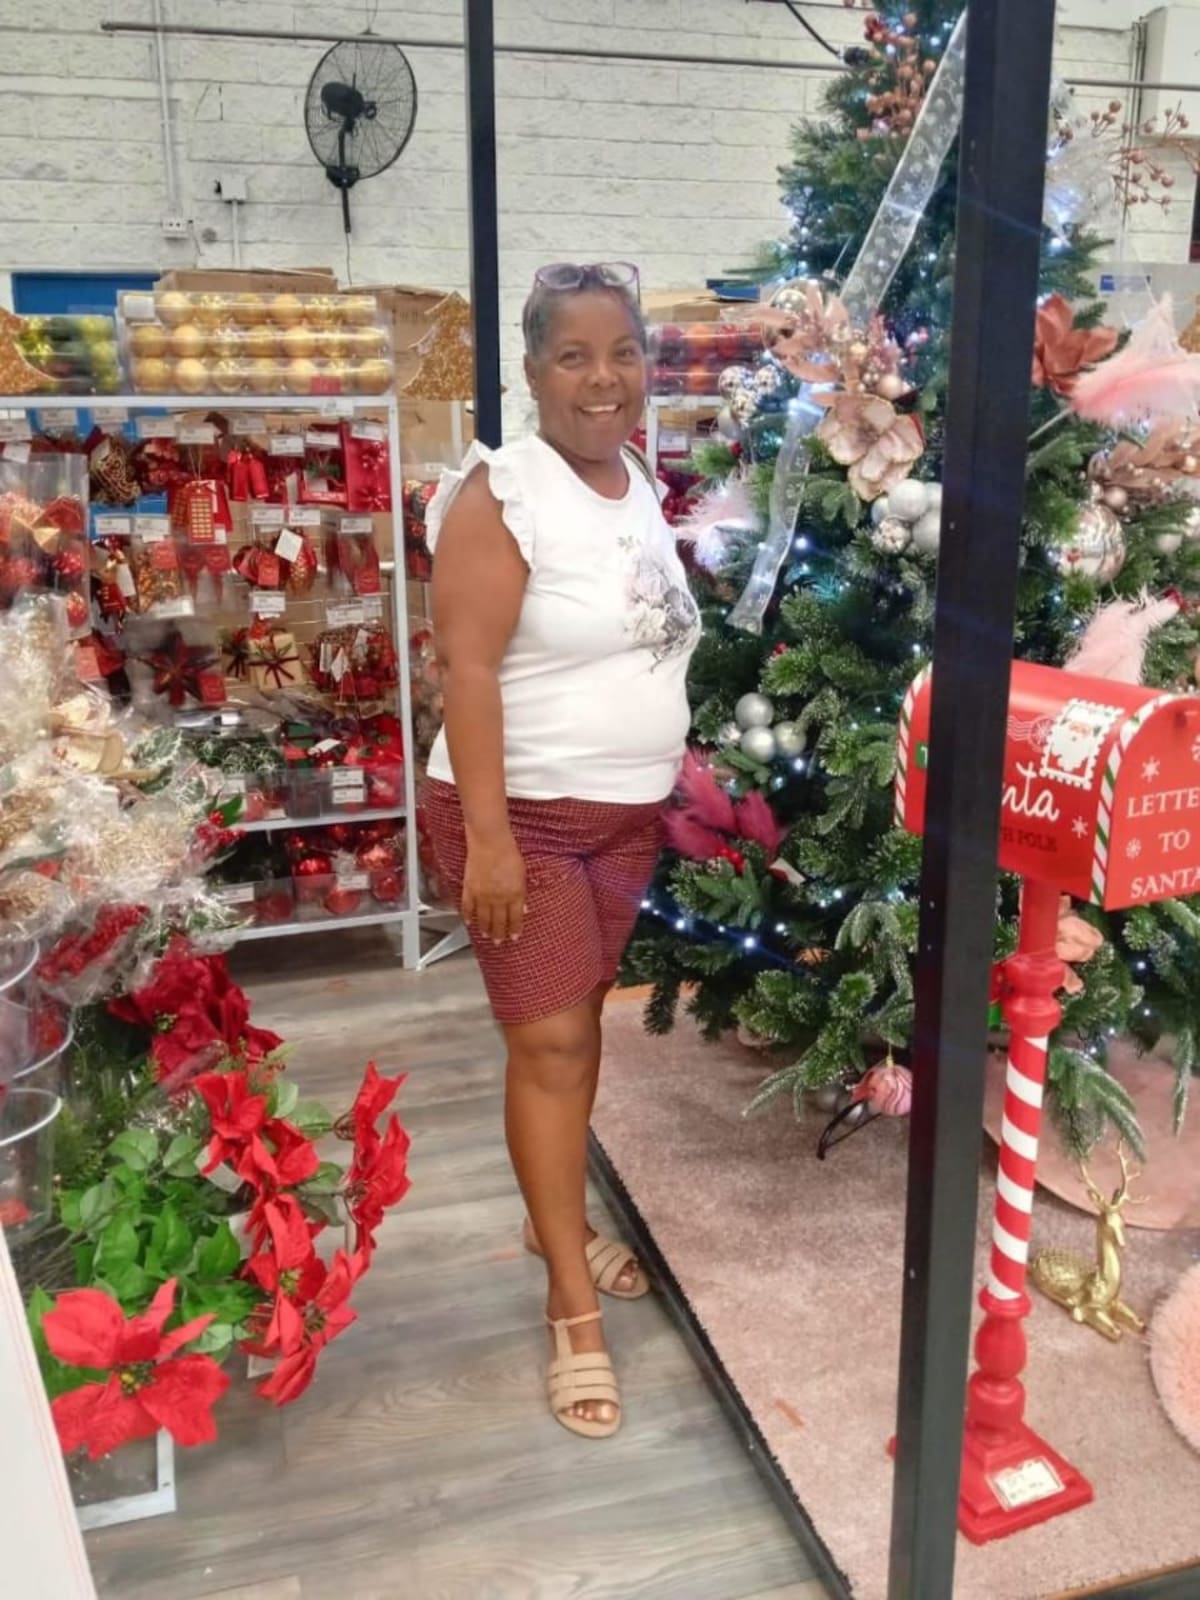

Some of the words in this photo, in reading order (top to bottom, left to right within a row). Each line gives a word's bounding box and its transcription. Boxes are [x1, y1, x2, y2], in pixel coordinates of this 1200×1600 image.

[1002, 761, 1060, 822] nta
[1126, 787, 1200, 819] LETTE
[1158, 829, 1191, 853] TO
